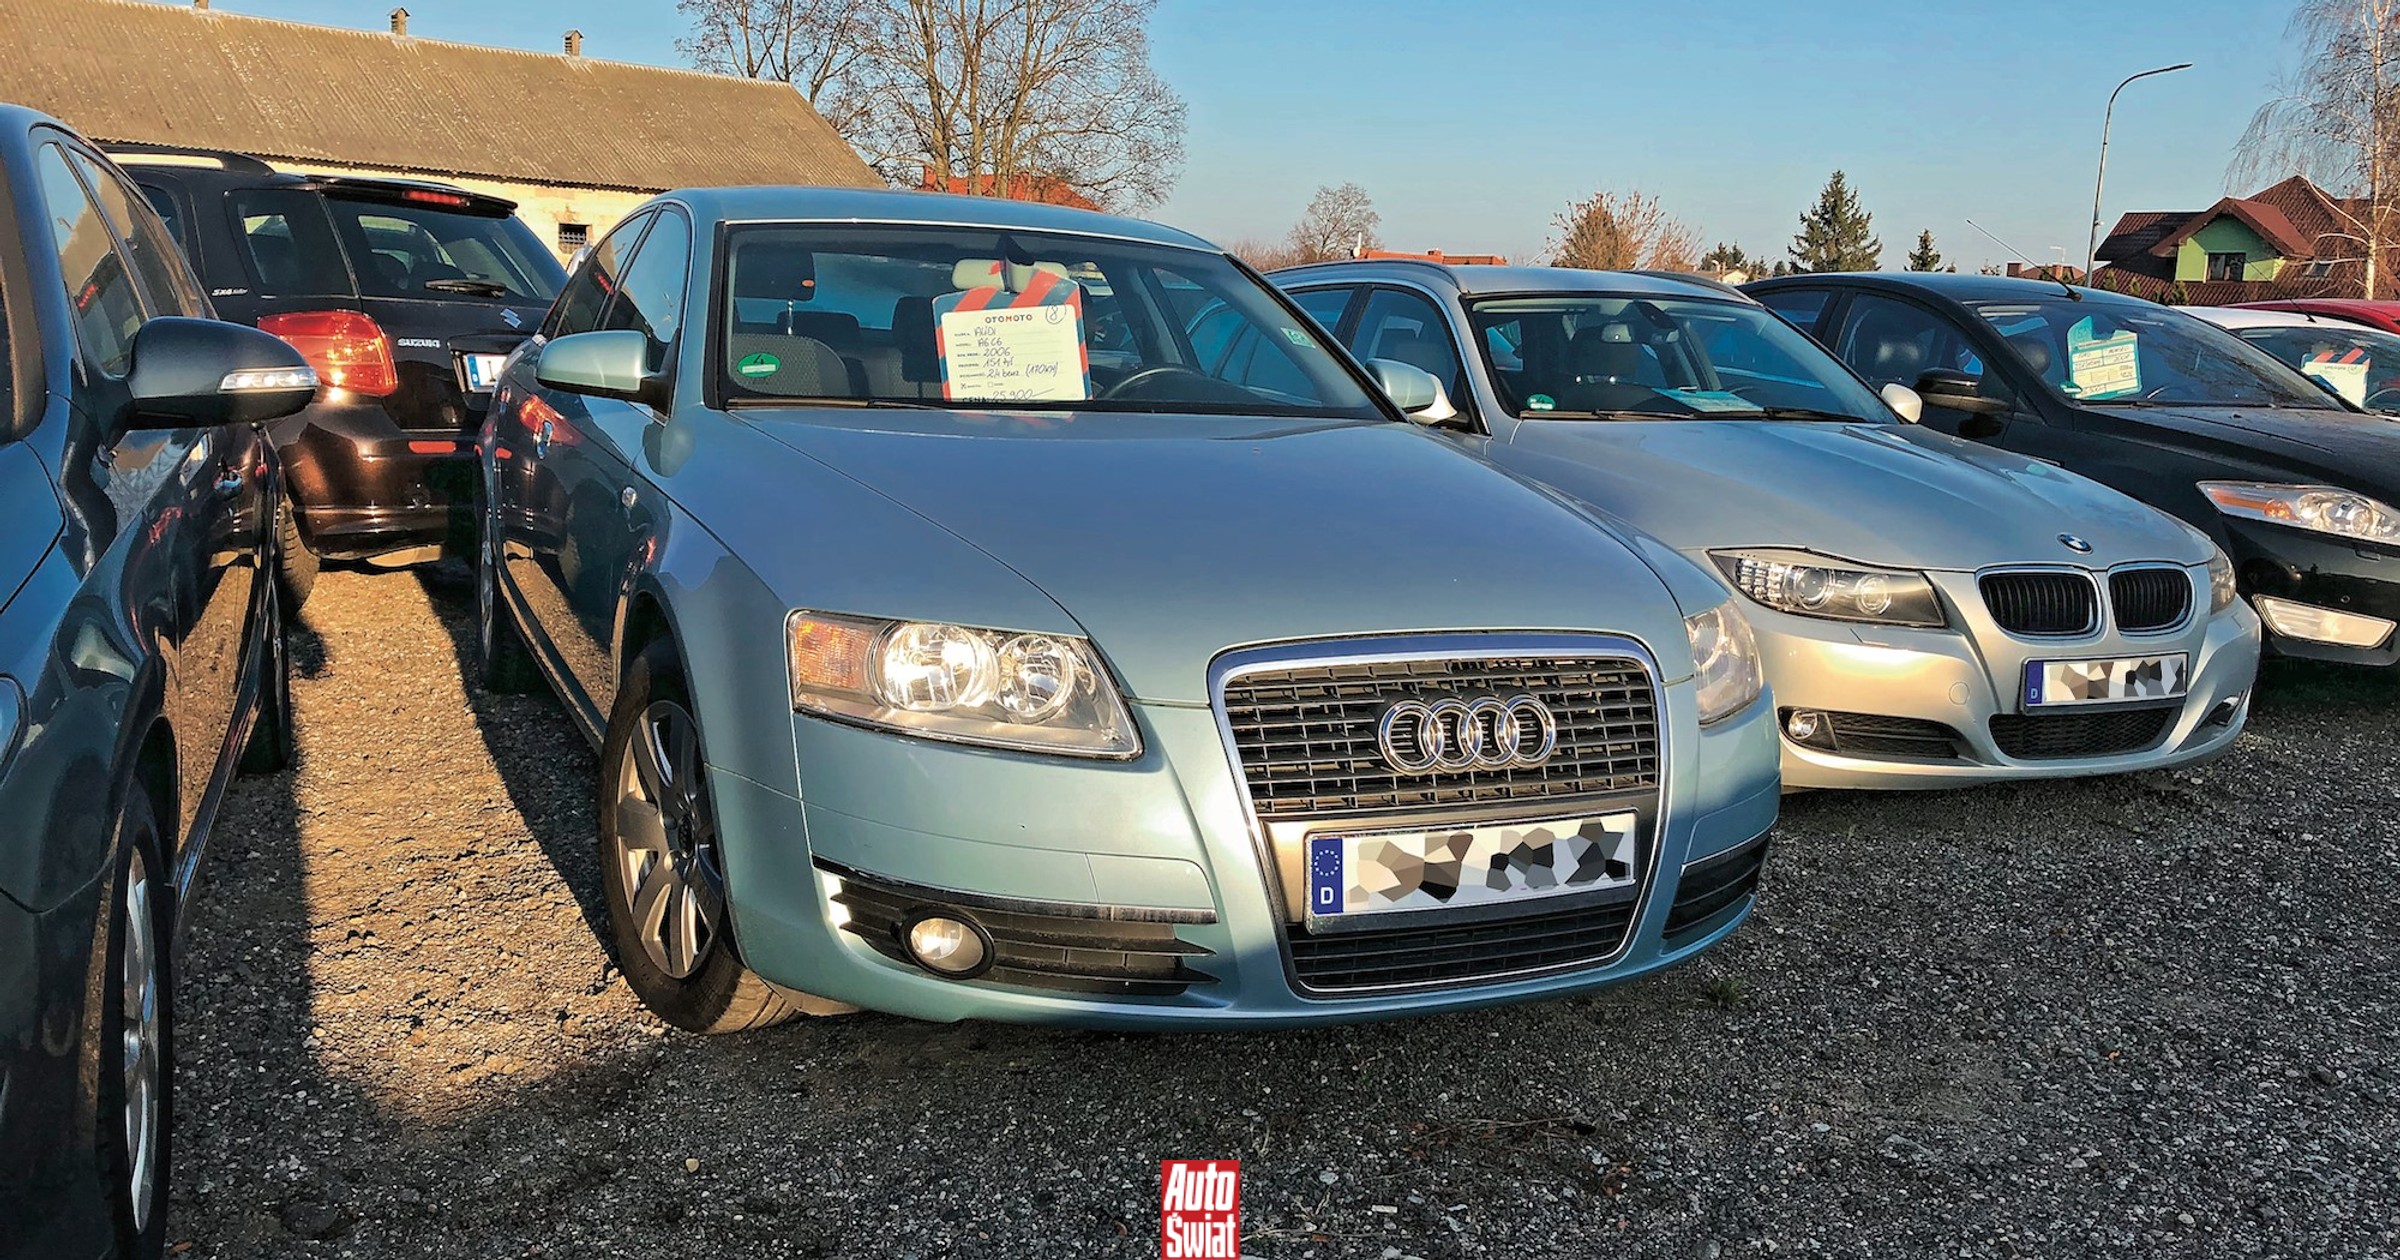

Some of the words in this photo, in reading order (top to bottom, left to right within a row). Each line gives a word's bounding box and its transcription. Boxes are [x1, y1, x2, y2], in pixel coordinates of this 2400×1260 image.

[985, 314, 1033, 324] OTOMOTO
[974, 327, 996, 336] AUDI
[398, 338, 440, 349] SUZUKI
[984, 347, 1010, 357] 2006
[2031, 688, 2038, 698] D
[1320, 886, 1334, 904] D
